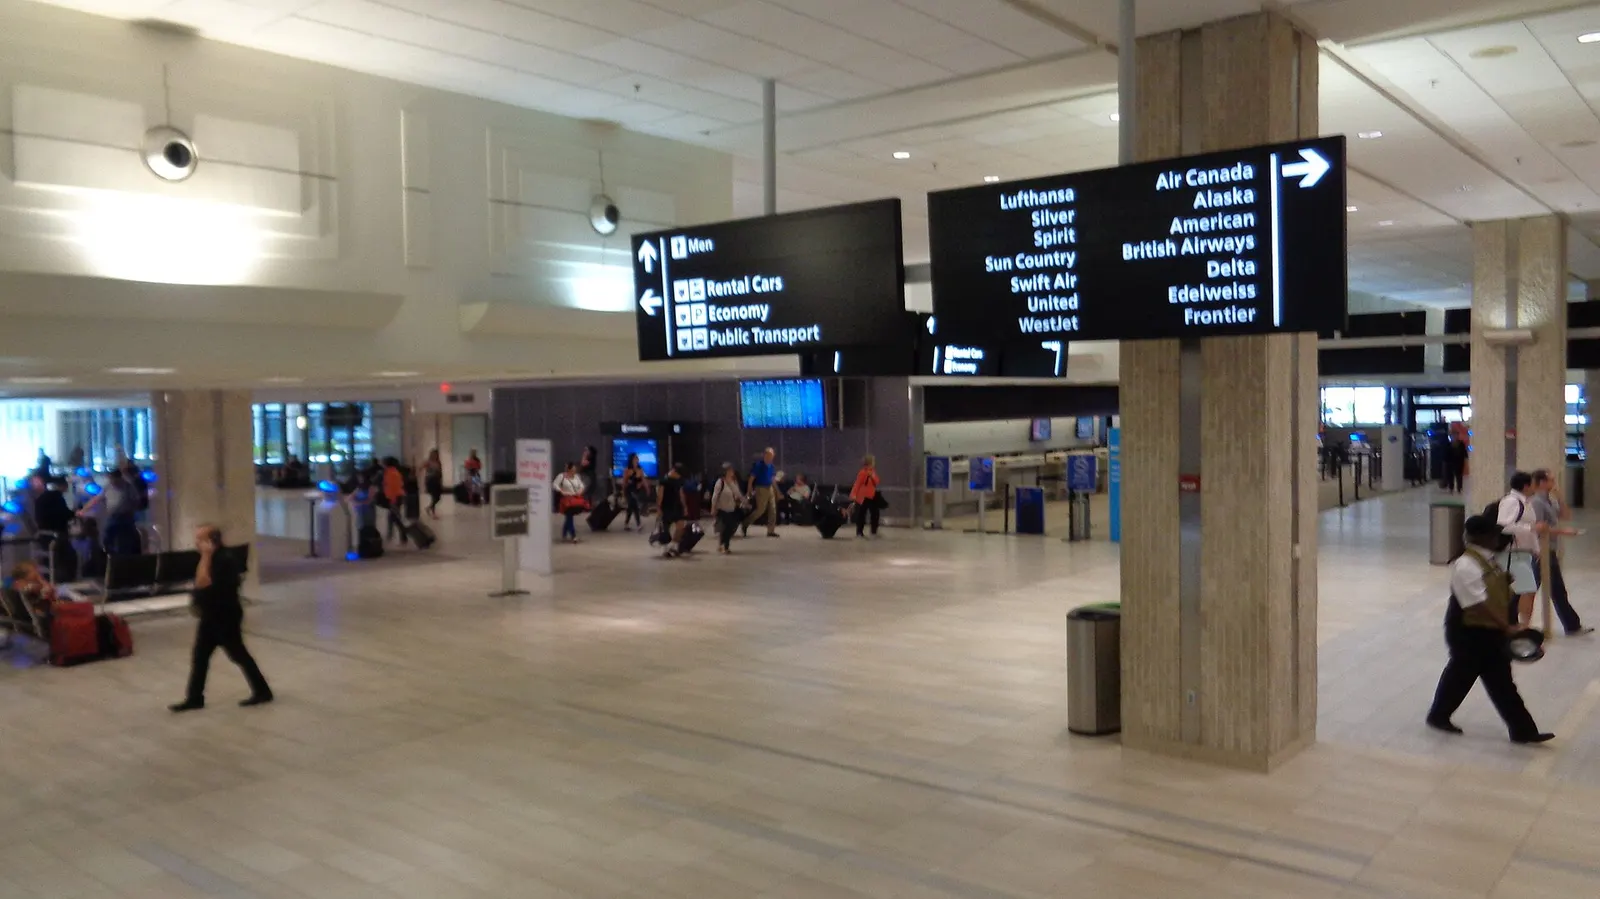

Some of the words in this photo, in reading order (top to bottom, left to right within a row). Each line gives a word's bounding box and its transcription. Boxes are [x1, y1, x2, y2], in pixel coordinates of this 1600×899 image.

[1156, 170, 1182, 190] Air
[1186, 162, 1255, 186] Canada
[1000, 187, 1076, 210] Lufthansa
[1193, 185, 1256, 209] Alaska
[1031, 208, 1076, 227] Silver
[1170, 211, 1256, 235] American
[687, 236, 714, 254] Men
[1033, 228, 1077, 249] Spirit
[1122, 239, 1178, 260] British
[1180, 234, 1256, 255] Airways
[985, 255, 1013, 273] Sun
[1015, 250, 1077, 270] Country
[1206, 257, 1257, 278] Delta
[706, 276, 750, 298] Rental
[752, 274, 784, 293] Cars
[1010, 273, 1051, 293] Swift
[1053, 271, 1078, 290] Air
[1168, 282, 1257, 304] Edelweiss
[708, 302, 770, 324] Economy
[1027, 292, 1080, 313] United
[1018, 314, 1080, 333] WestJet
[1184, 304, 1257, 325] Frontier
[709, 326, 750, 346] Public
[750, 324, 821, 346] Transport
